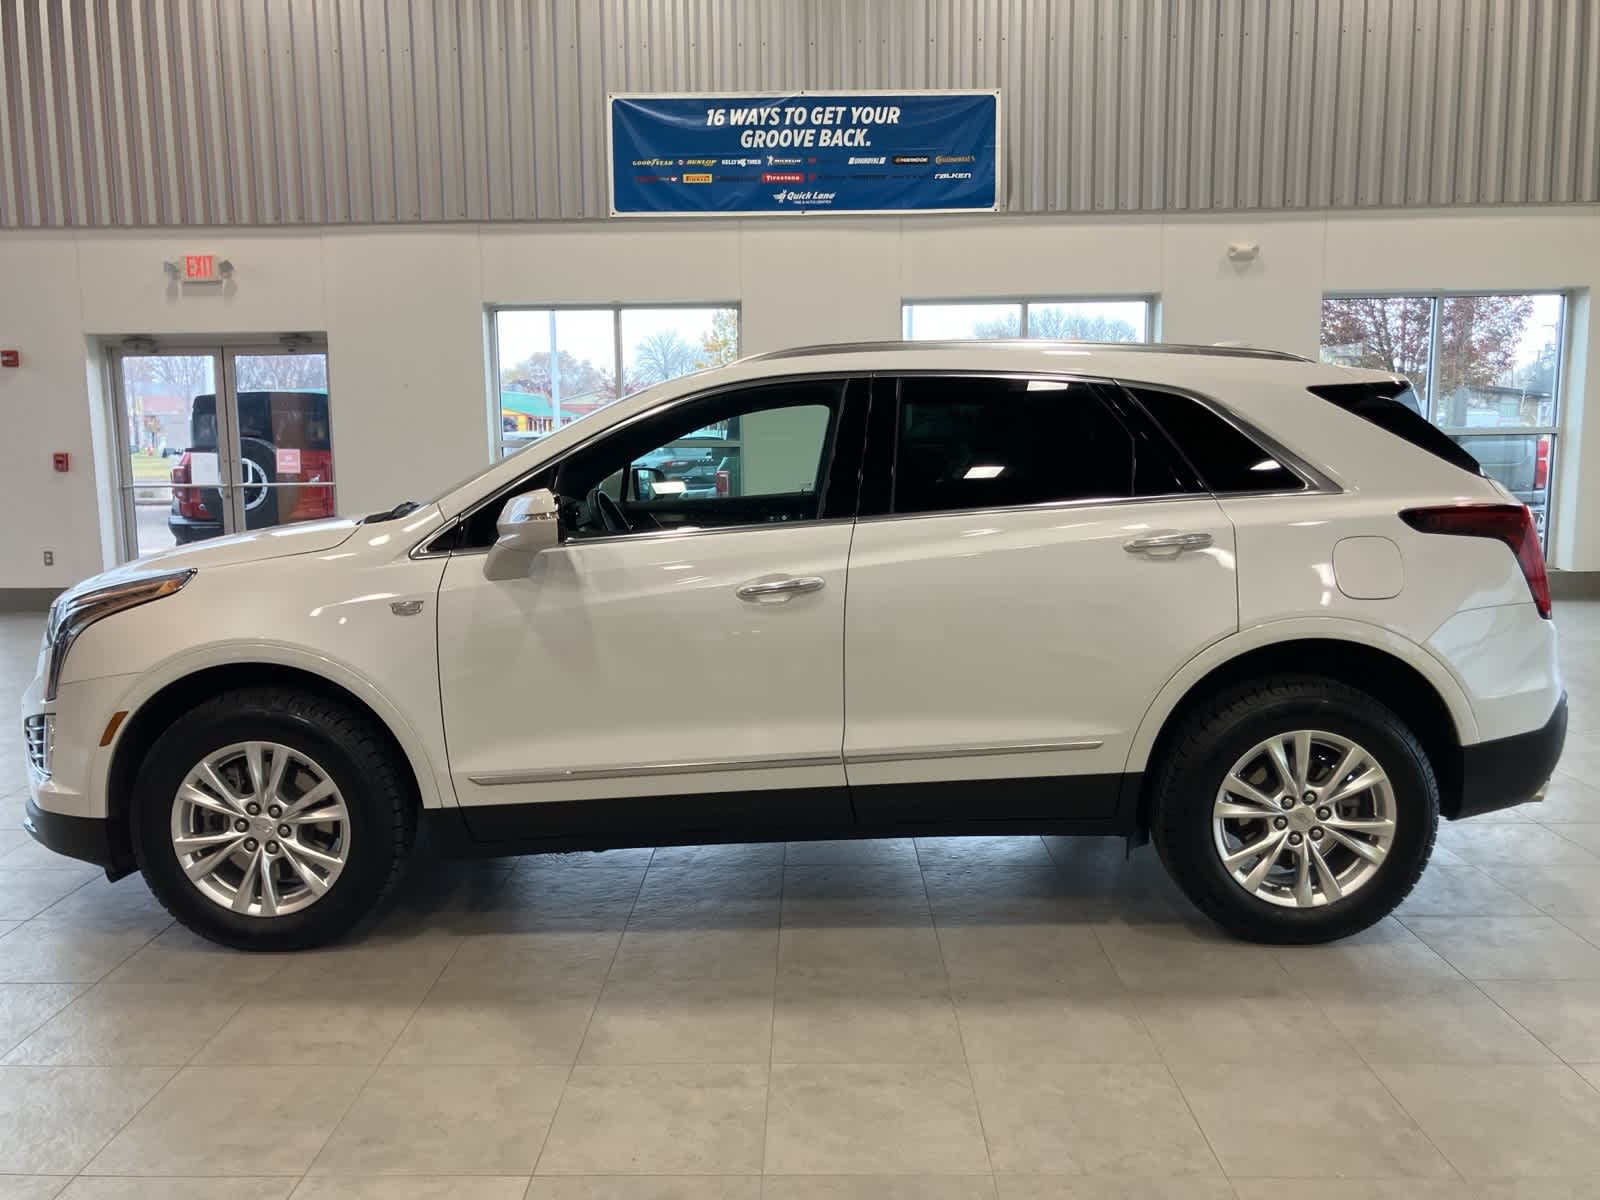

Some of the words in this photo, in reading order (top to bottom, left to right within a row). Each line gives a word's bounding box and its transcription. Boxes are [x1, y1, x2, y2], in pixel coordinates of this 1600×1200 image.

[706, 109, 726, 126] 16
[729, 107, 780, 126] WAYS
[784, 106, 807, 125] TO
[810, 106, 847, 125] GET
[851, 106, 901, 124] YOUR
[740, 129, 816, 148] GROOVE
[818, 128, 872, 147] BACK.
[632, 158, 673, 166] GOODYEAR
[687, 159, 717, 167] DUNLOP
[934, 172, 972, 180] FALKEN
[787, 191, 812, 200] Quick
[812, 191, 836, 200] Lane
[185, 255, 213, 278] EXIT
